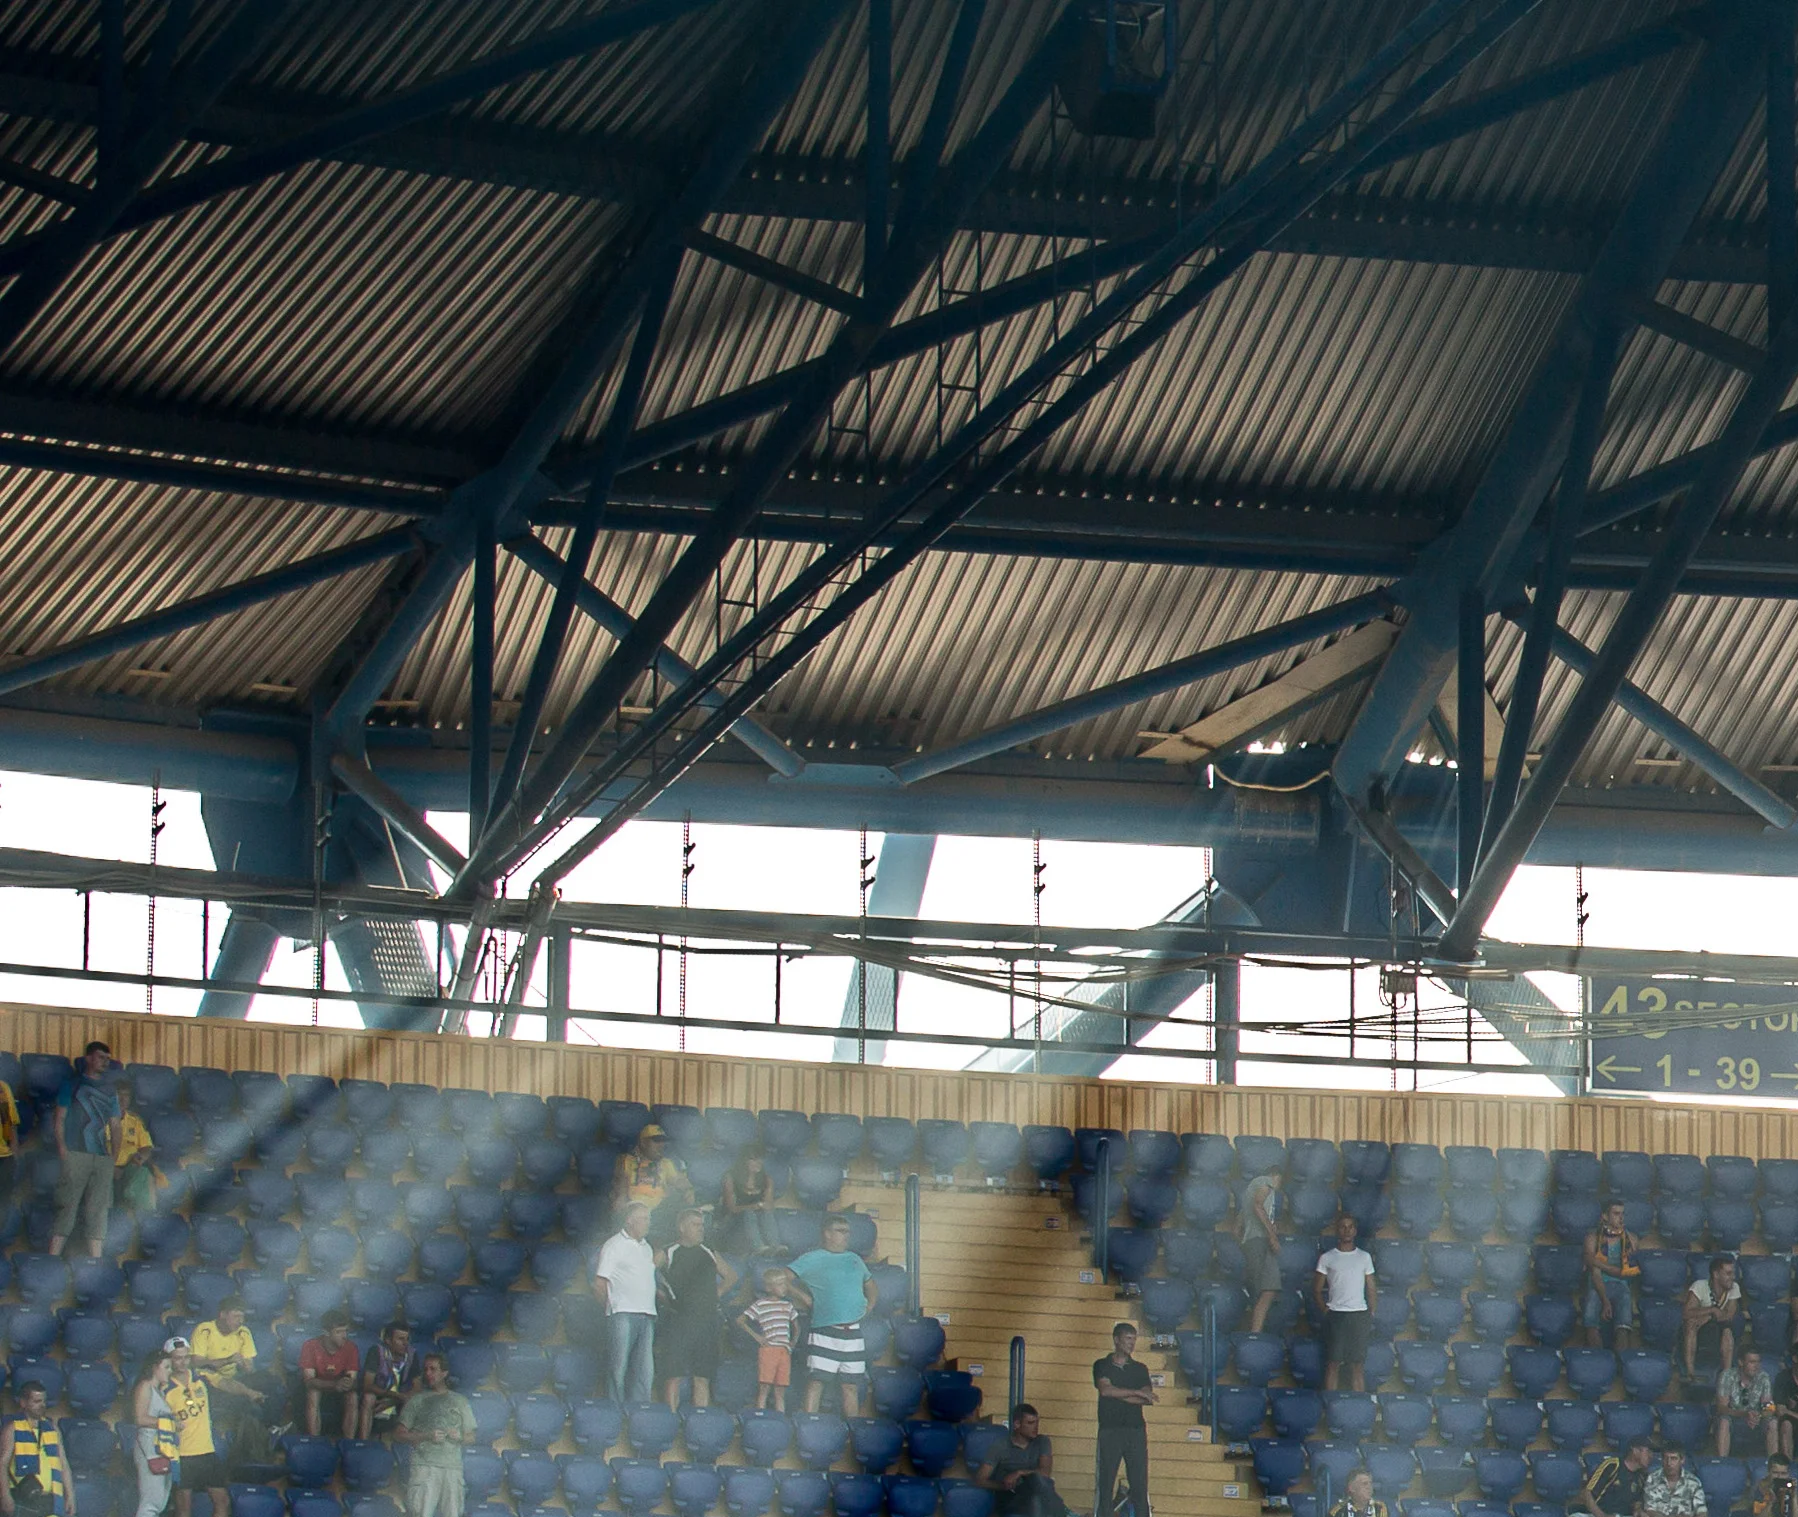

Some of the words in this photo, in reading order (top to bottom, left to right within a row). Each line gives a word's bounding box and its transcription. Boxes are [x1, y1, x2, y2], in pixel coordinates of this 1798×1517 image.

[1599, 985, 1668, 1039] 43
[1656, 1054, 1673, 1087] 1
[1716, 1056, 1761, 1091] 39
